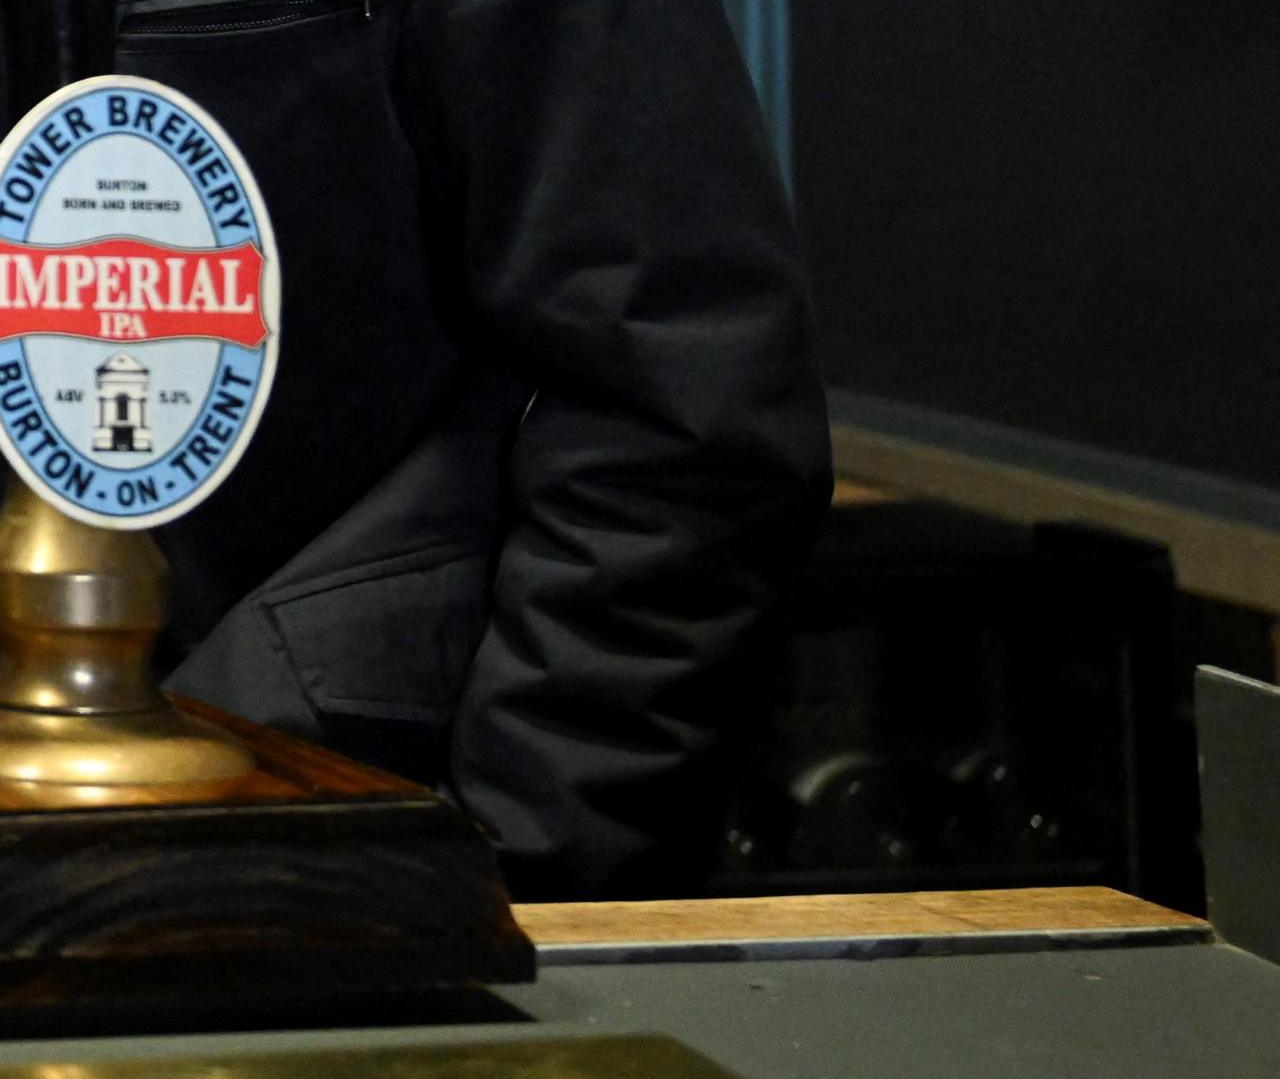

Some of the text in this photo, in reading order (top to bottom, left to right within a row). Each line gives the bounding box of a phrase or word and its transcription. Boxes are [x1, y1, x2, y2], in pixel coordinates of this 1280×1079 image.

[106, 94, 251, 232] BREWERY
[98, 311, 148, 338] IPA
[115, 479, 159, 507] ON
[170, 365, 252, 481] TRENT
